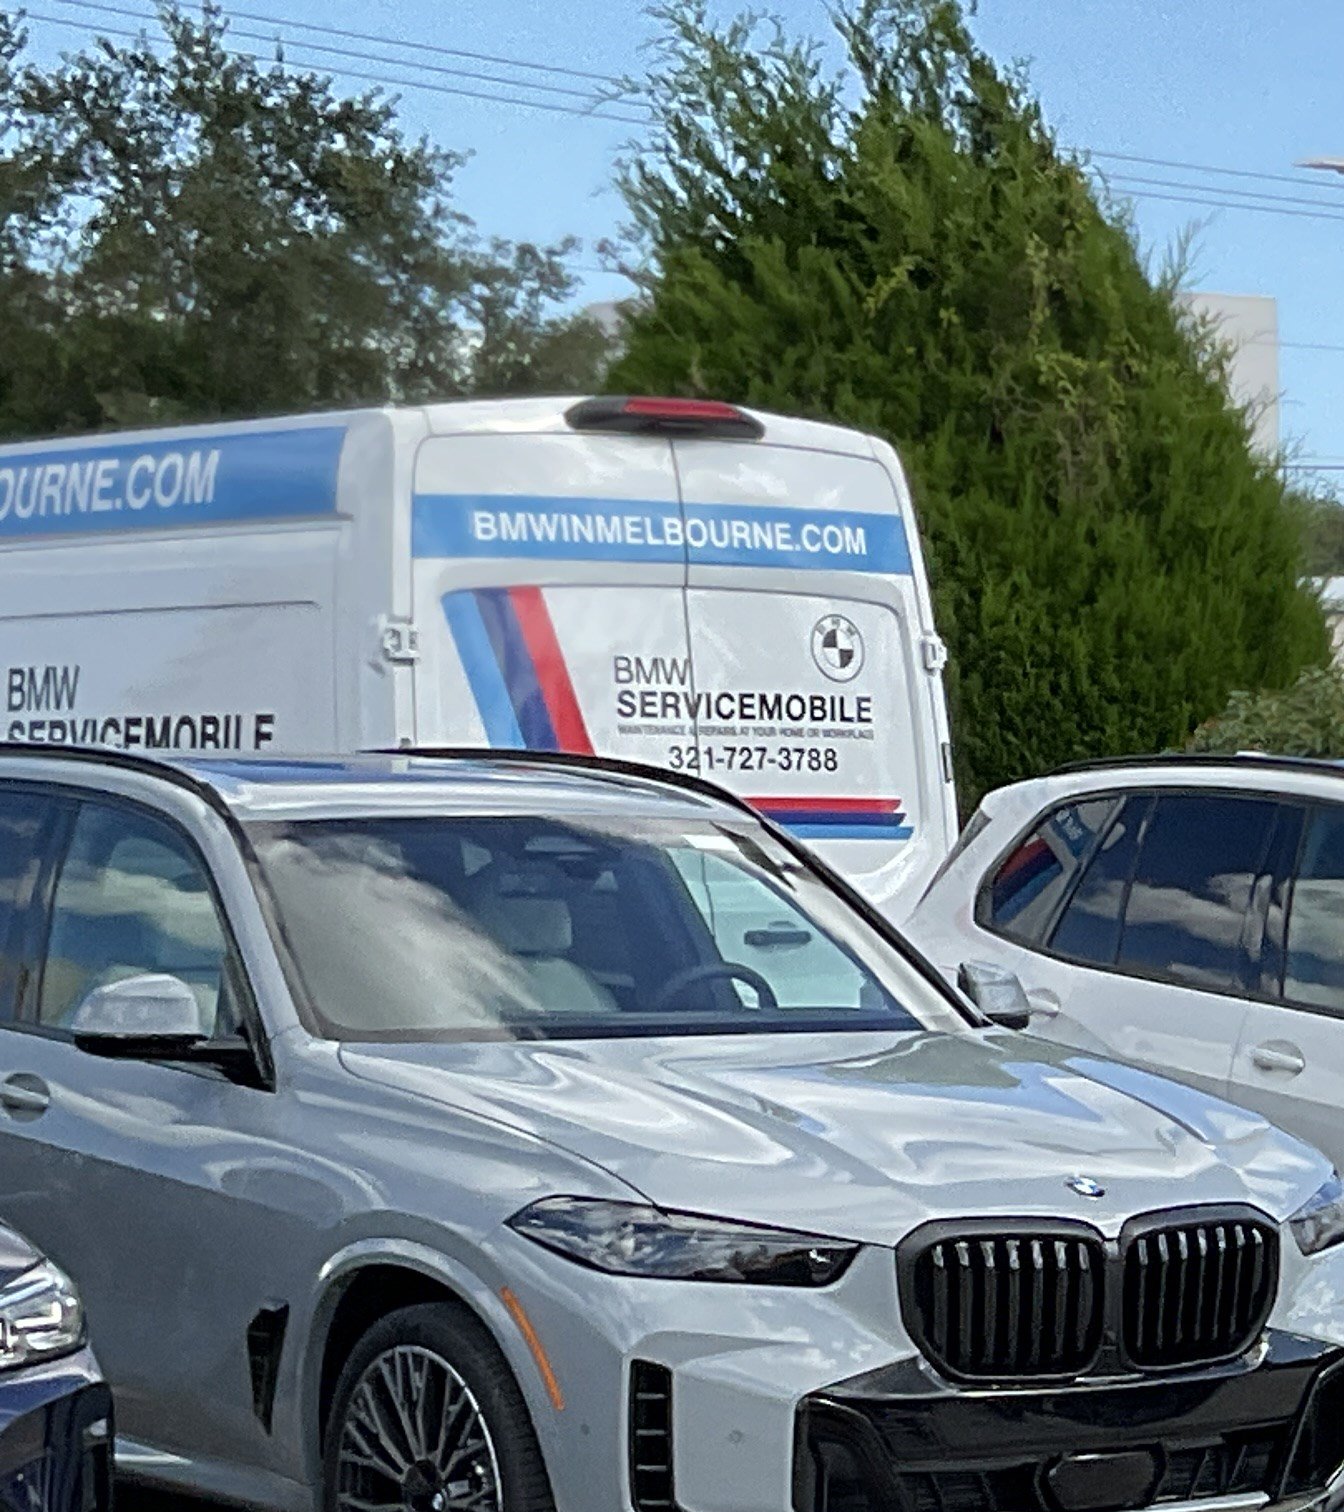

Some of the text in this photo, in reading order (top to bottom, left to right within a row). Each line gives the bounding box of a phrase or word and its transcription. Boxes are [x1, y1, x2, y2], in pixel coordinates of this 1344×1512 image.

[473, 510, 868, 556] BMWINMELBOURNE.COM
[614, 656, 691, 686] BMW
[7, 664, 81, 712] BMW
[617, 690, 873, 723] SERVICEMOBILE
[668, 745, 838, 772] 321-727-3788
